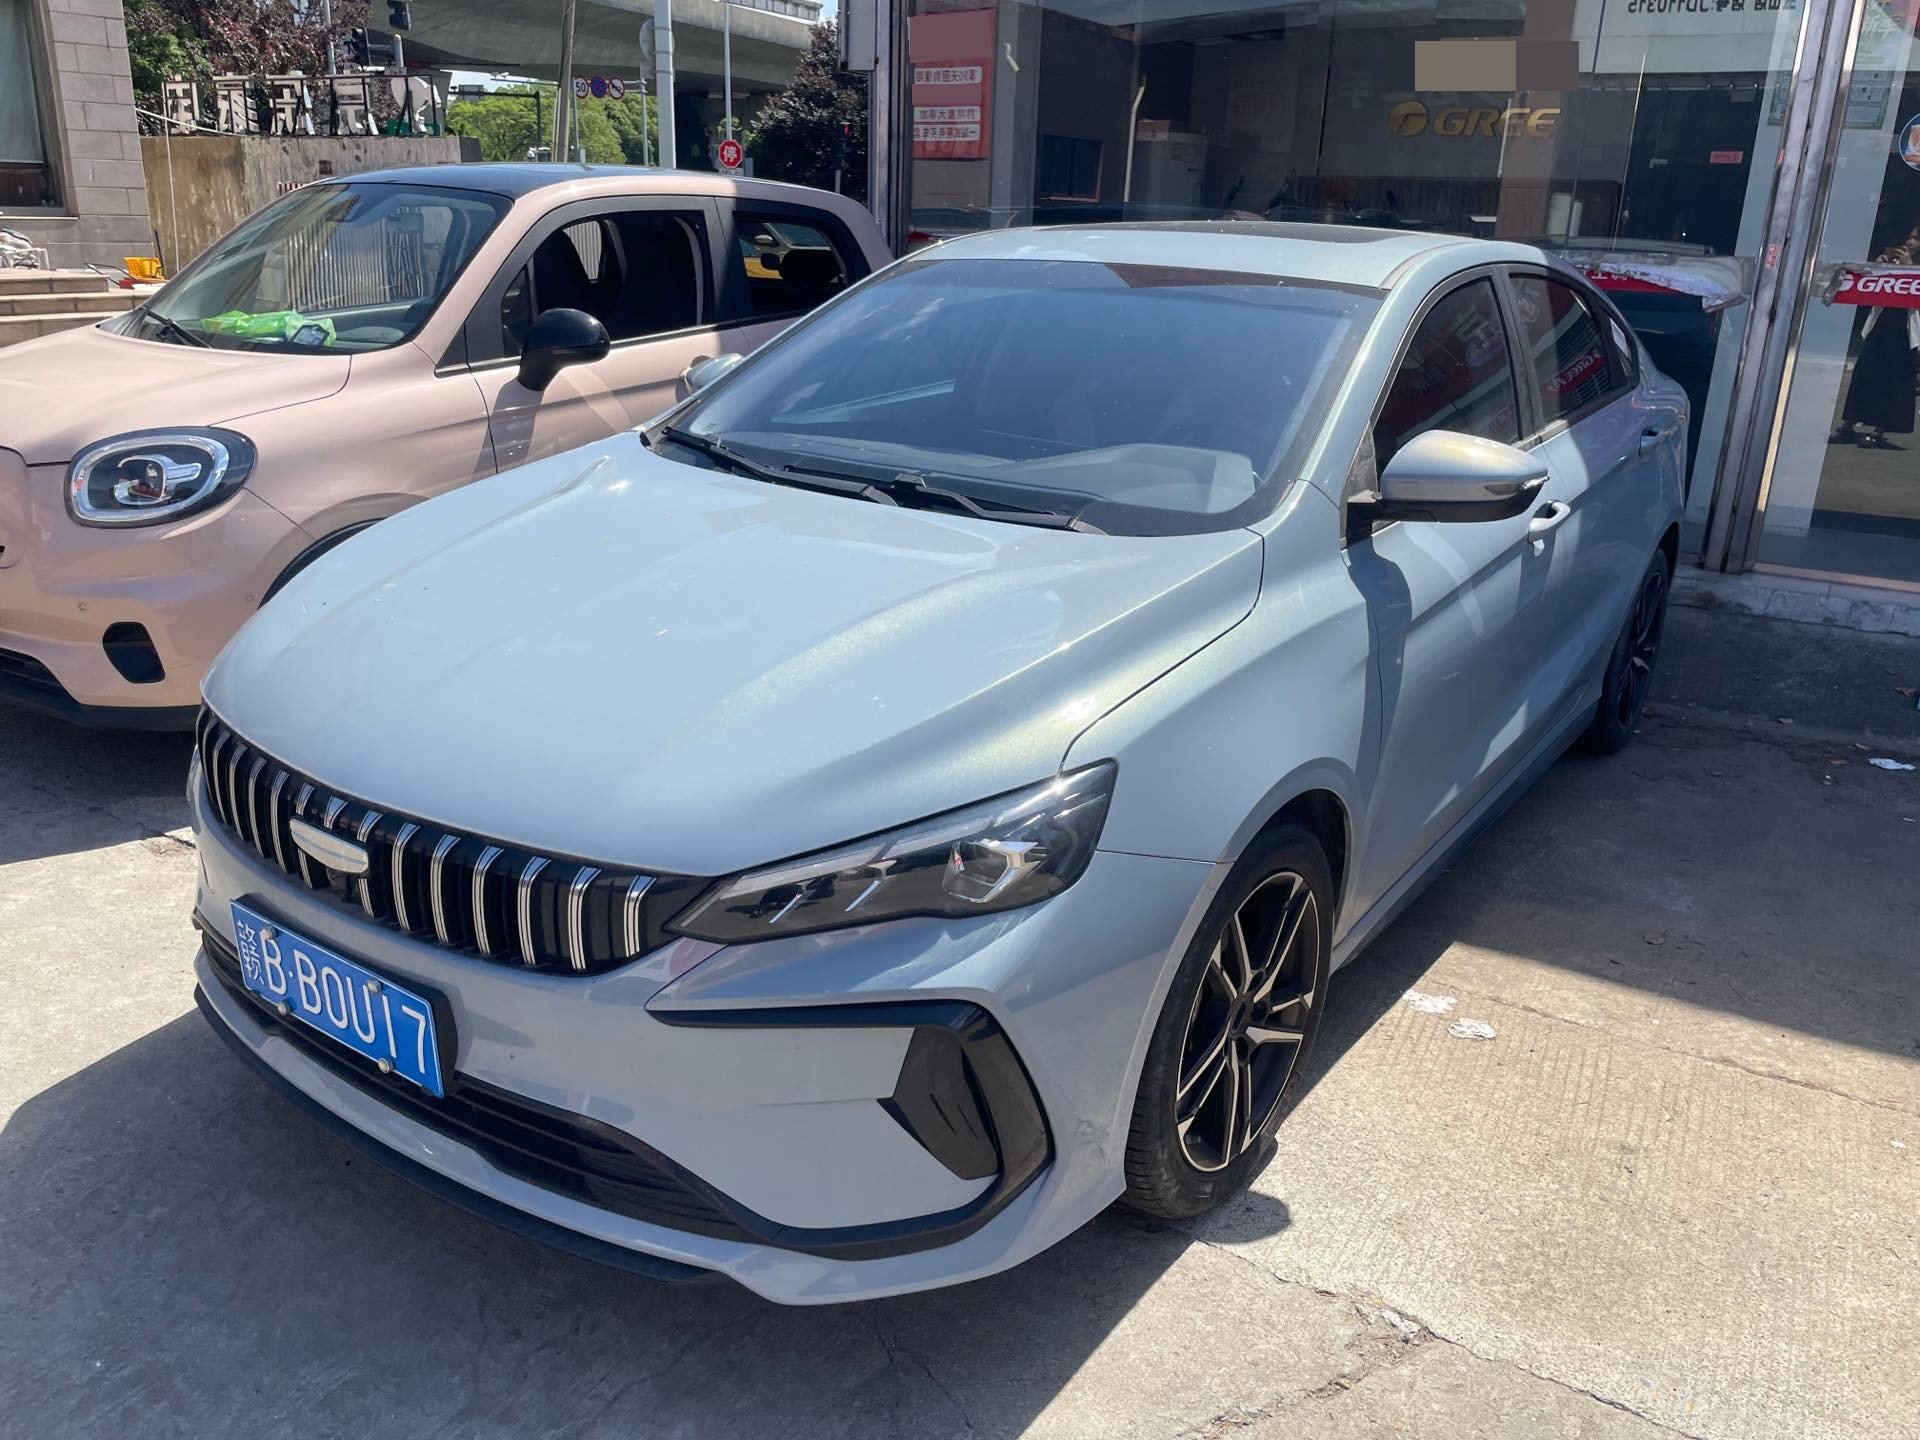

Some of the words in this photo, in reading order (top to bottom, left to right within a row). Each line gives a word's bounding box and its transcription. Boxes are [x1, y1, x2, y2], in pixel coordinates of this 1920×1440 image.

[575, 82, 586, 93] 50
[1435, 106, 1561, 137] GREE
[723, 145, 738, 162] 停
[1857, 275, 1920, 295] GREE
